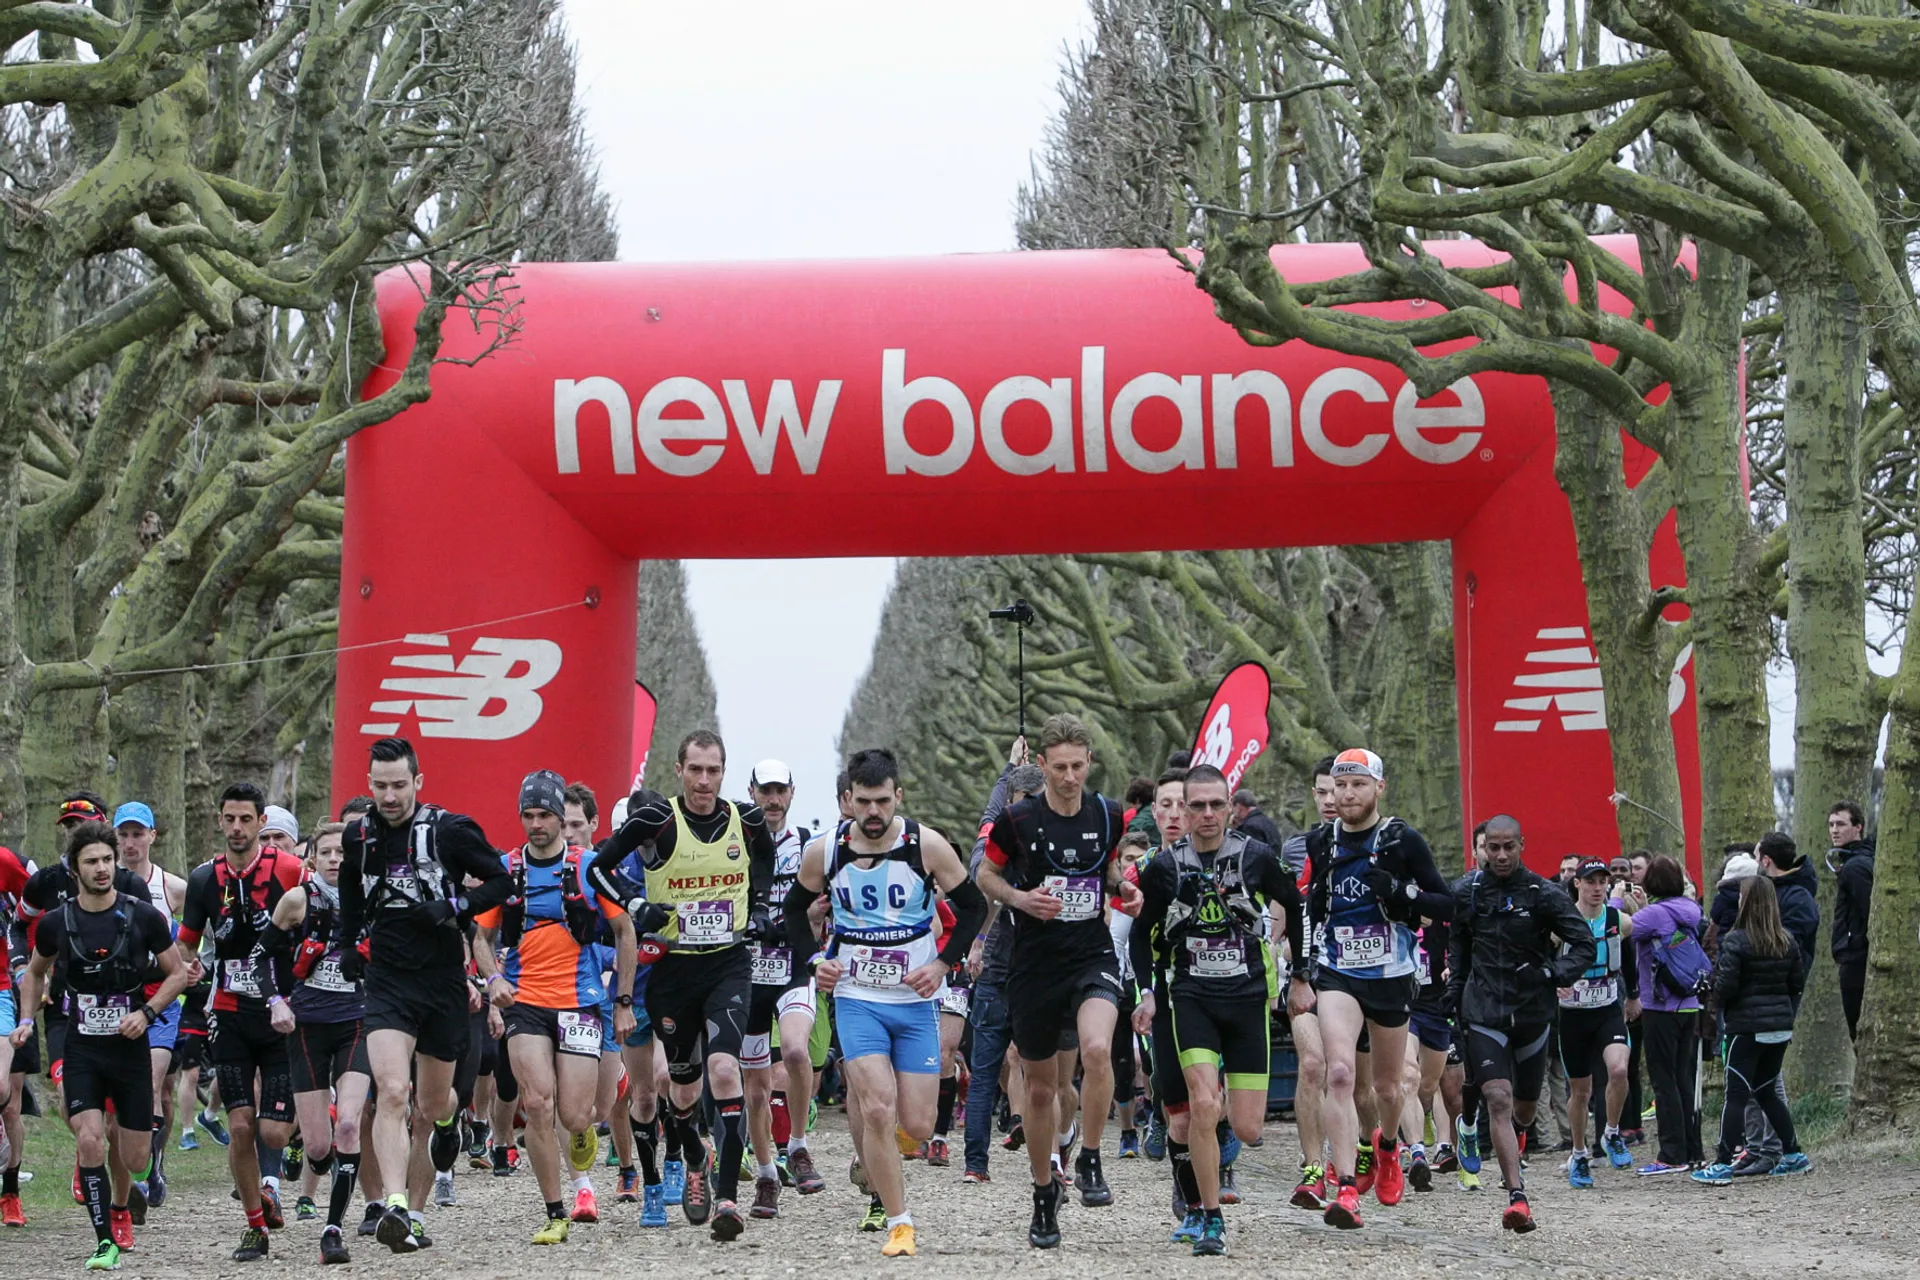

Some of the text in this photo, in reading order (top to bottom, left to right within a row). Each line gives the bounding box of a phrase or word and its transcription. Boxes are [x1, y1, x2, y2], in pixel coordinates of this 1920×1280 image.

[553, 345, 1486, 477] new balance
[359, 632, 564, 741] NB
[667, 872, 745, 889] MELFOR
[689, 914, 723, 926] 8149
[1344, 937, 1382, 951] 8208
[1198, 950, 1237, 962] 8695
[751, 959, 784, 970] 6983
[860, 961, 897, 976] 7253
[88, 1008, 121, 1019] 6921
[568, 1025, 599, 1039] 8749
